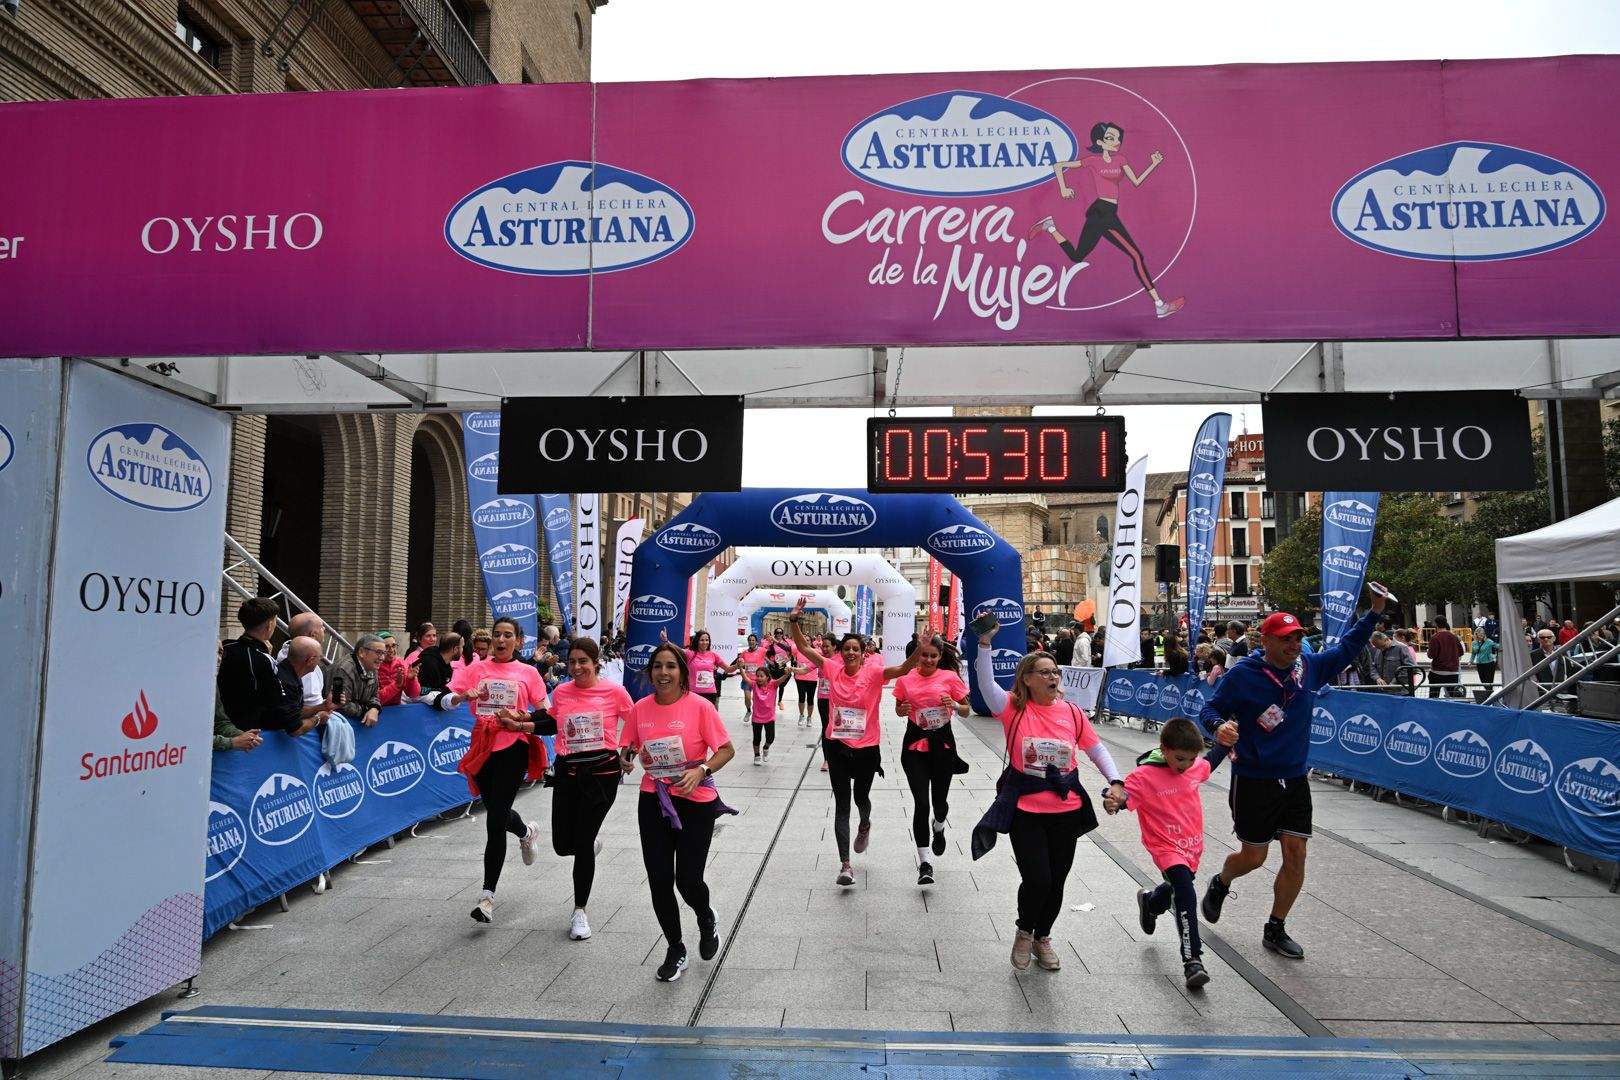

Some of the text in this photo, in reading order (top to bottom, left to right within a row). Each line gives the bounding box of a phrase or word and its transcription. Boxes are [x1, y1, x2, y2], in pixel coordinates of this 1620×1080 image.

[896, 126, 1051, 138] CENTRAL LECHERA
[860, 131, 1058, 170] ASTURIANA
[1394, 180, 1574, 196] CENTRAL LECHERA
[502, 198, 668, 212] CENTRAL LECHERA
[821, 190, 1015, 244] Carrera
[1354, 188, 1586, 232] ASTURIANA
[140, 212, 324, 254] OYSHO
[463, 206, 674, 246] ASTURIANA
[868, 238, 1090, 331] de la Mujer
[538, 428, 708, 462] OYSHO
[1307, 425, 1492, 462] OYSHO
[97, 443, 204, 498] ASTURIANA
[120, 445, 201, 472] CENTRAL LECHERA
[778, 506, 868, 526] ASTURIANA
[660, 532, 716, 546] ASTURIANA
[933, 537, 990, 548] ASTURIANA
[772, 560, 852, 576] OYSHO
[1110, 488, 1140, 629] OYSHO
[80, 572, 204, 616] OYSHO
[630, 606, 674, 617] ASTURIANA
[1341, 726, 1378, 747] ASTURIANA
[1386, 734, 1427, 757] ASTURIANA
[80, 742, 186, 781] Santander
[1437, 744, 1486, 769] ASTURIANA
[372, 760, 422, 788] ASTURIANA
[317, 780, 362, 808] ASTURIANA
[256, 798, 312, 836] ASTURIANA
